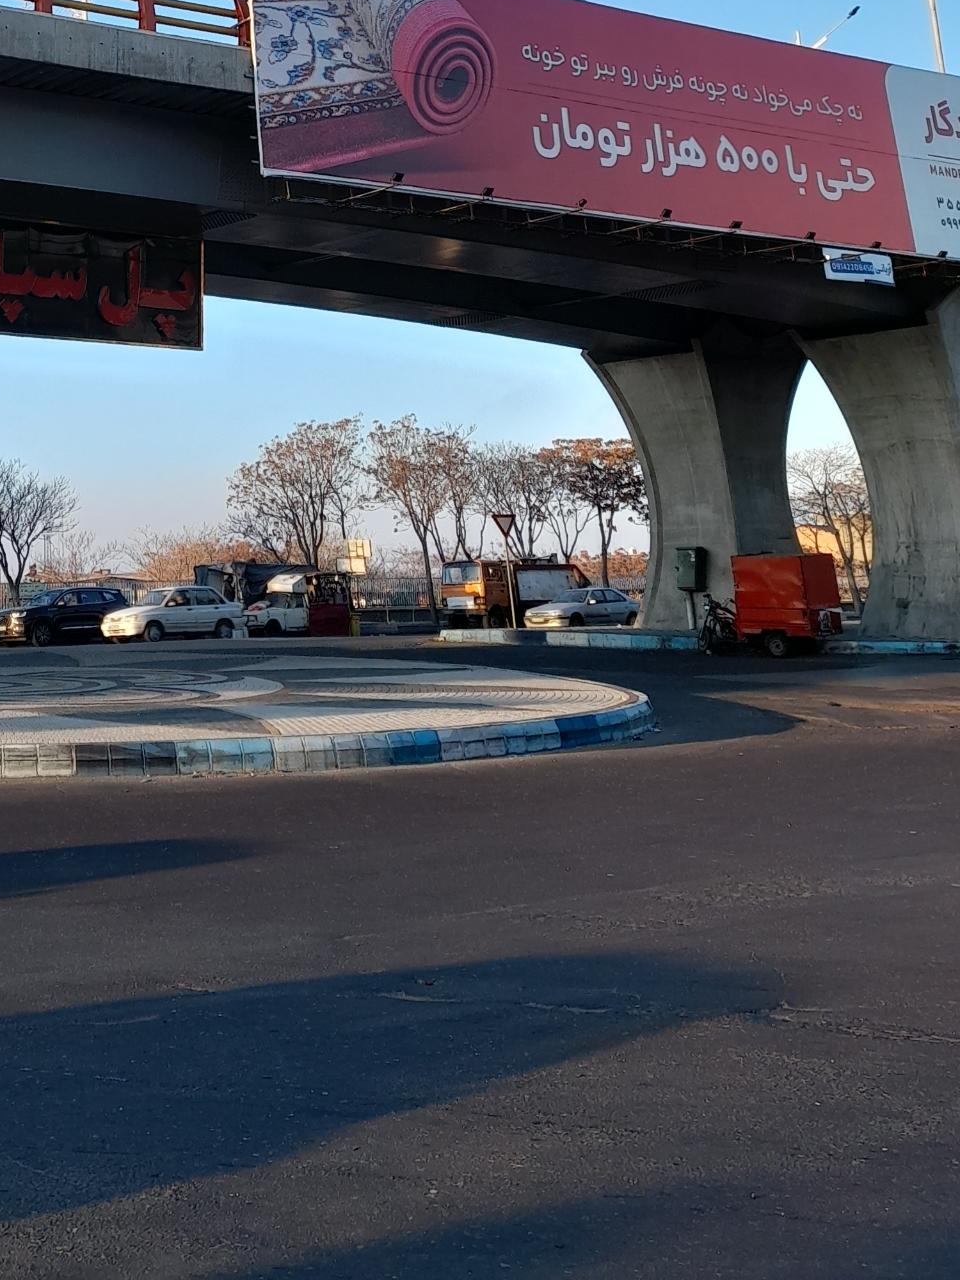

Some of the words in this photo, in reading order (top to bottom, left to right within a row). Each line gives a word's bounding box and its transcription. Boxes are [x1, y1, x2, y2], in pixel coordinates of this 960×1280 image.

[521, 43, 567, 71] خونه
[570, 53, 589, 76] تو
[593, 61, 617, 83] ببر
[621, 65, 639, 87] رو
[642, 64, 685, 94] فرش
[689, 75, 729, 106] چونه
[731, 81, 749, 101] نه
[816, 96, 844, 126] چک
[847, 104, 864, 121] نه
[531, 106, 632, 168] تومان
[640, 123, 707, 178] هزار
[716, 134, 780, 174] ۵۰۰
[784, 144, 809, 196] با
[816, 158, 876, 202] حتی
[97, 239, 197, 339] پل
